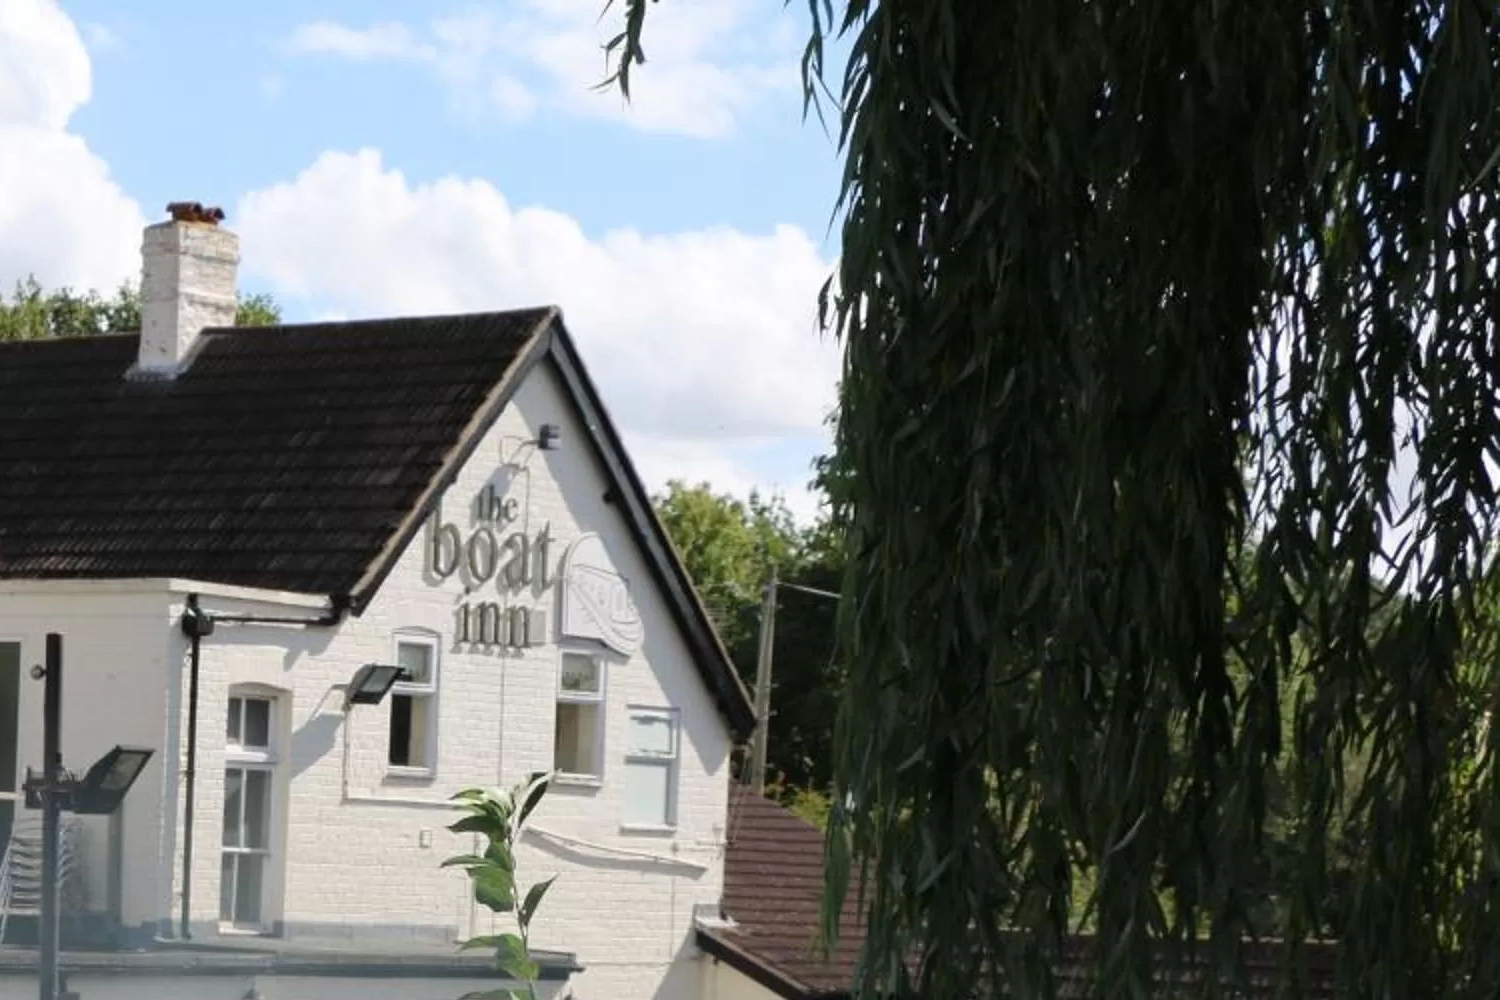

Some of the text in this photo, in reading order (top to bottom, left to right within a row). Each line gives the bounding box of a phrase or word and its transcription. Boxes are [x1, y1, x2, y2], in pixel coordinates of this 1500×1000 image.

[474, 484, 519, 523] the
[431, 497, 556, 590] boat
[456, 586, 531, 648] inn
